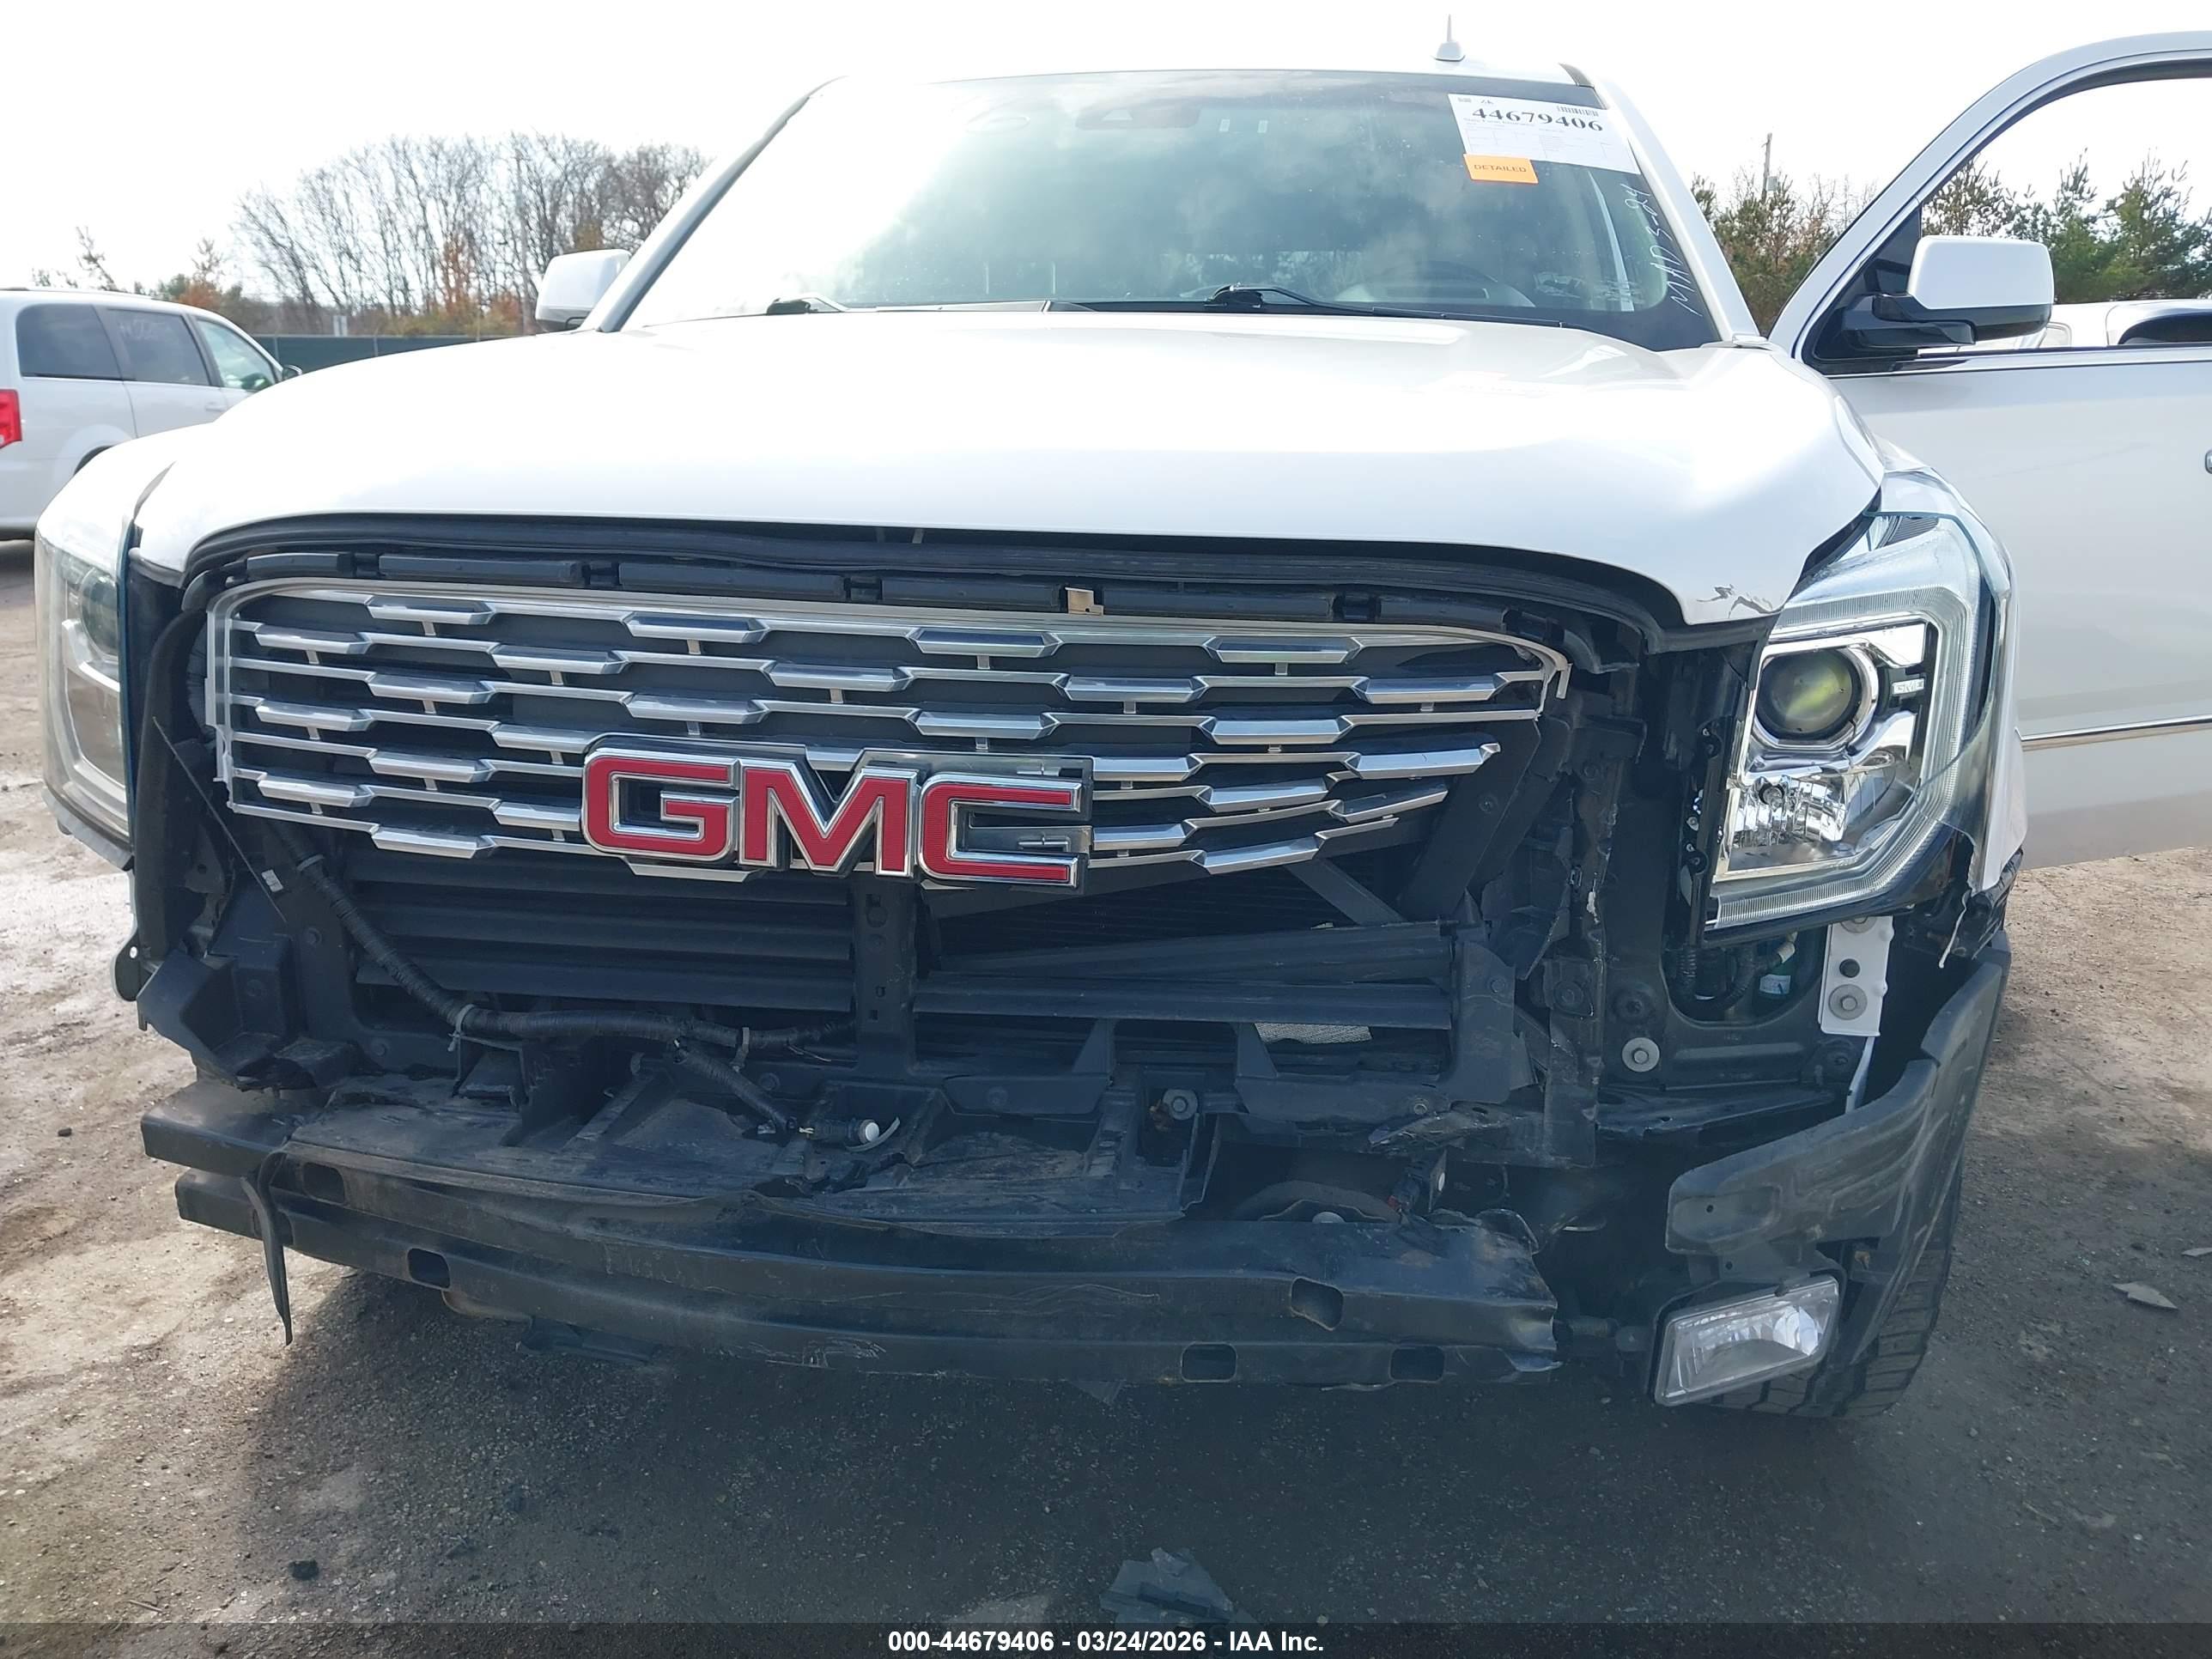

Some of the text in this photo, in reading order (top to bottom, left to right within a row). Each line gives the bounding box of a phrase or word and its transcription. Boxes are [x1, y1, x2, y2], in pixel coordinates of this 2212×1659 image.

[1472, 107, 1604, 131] 44679406
[1474, 163, 1527, 173] DETAILED
[584, 745, 1084, 888] GMC
